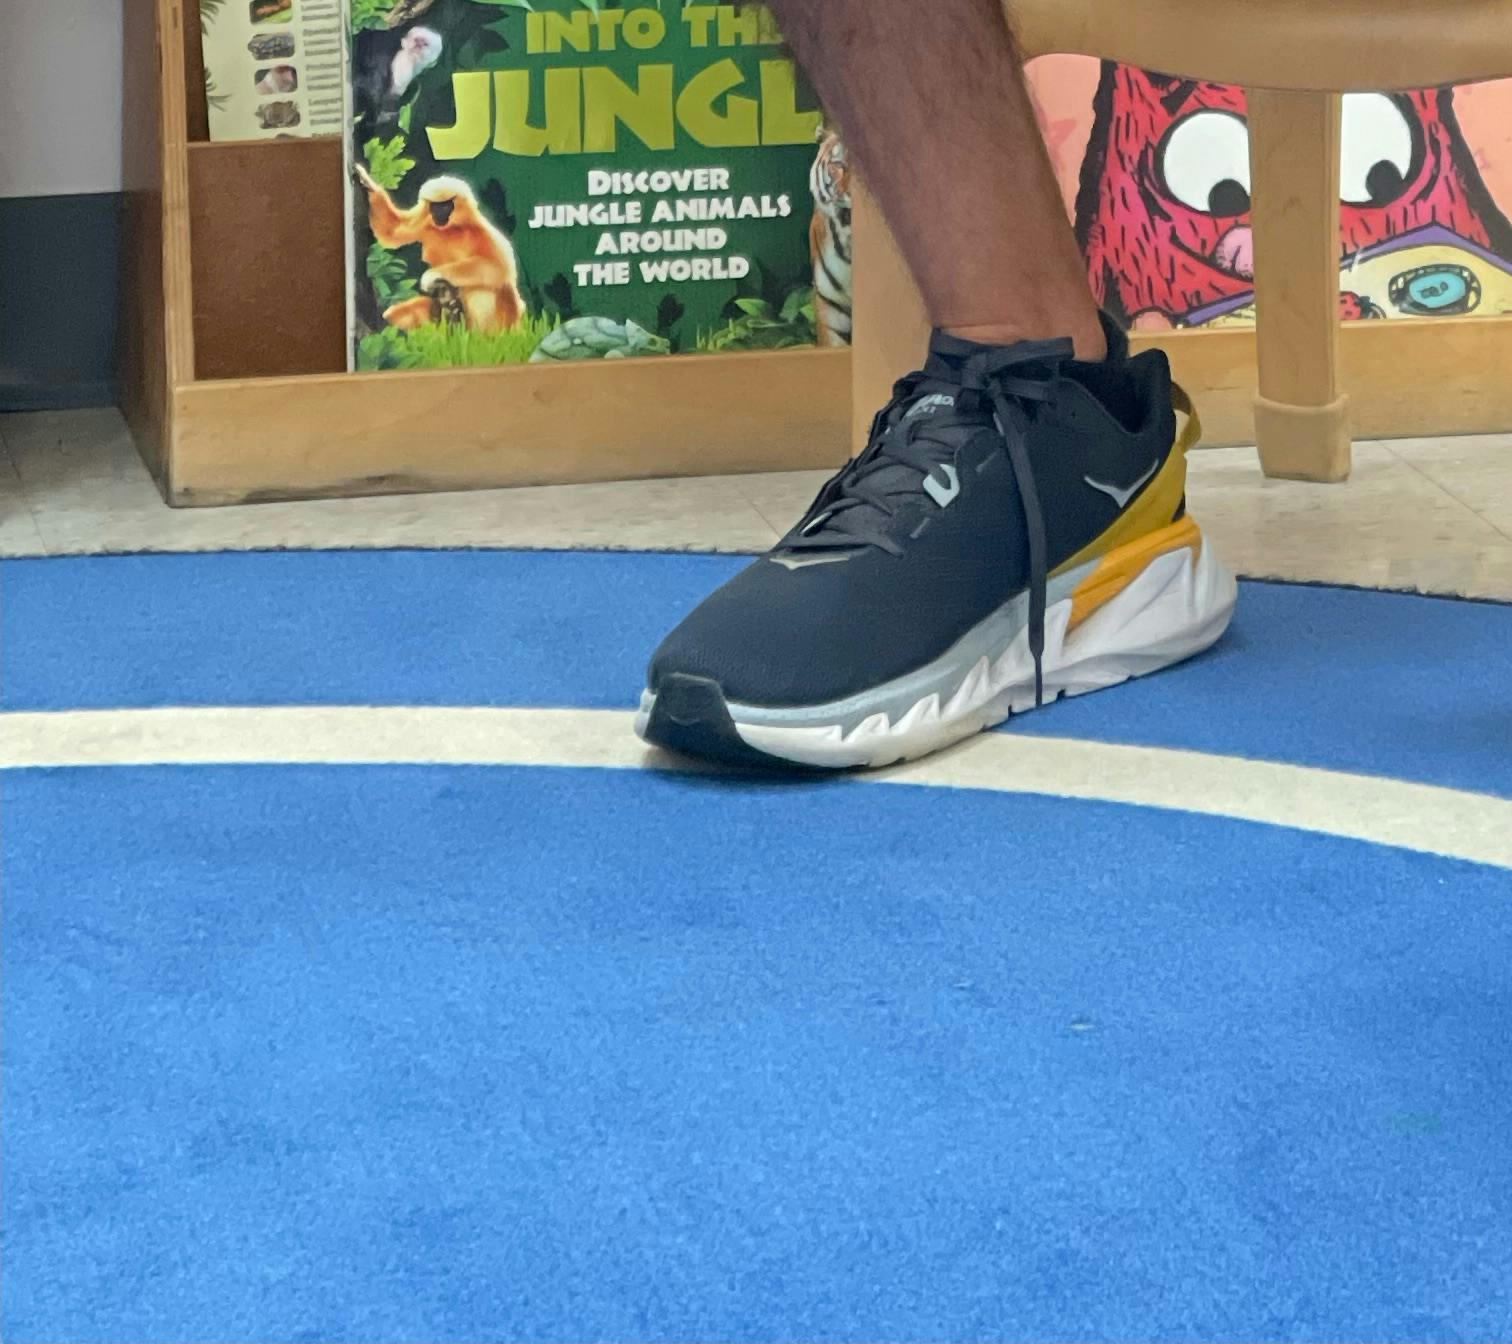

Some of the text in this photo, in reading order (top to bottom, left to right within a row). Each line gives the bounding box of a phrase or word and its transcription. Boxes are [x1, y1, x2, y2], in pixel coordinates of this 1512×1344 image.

[526, 8, 666, 55] INTO
[425, 57, 823, 160] JUNGL
[587, 168, 730, 196] DISCOVER
[528, 193, 792, 229] JUNGLE ANIMALS
[595, 228, 727, 256] AROUND
[573, 256, 750, 287] THE WORLD
